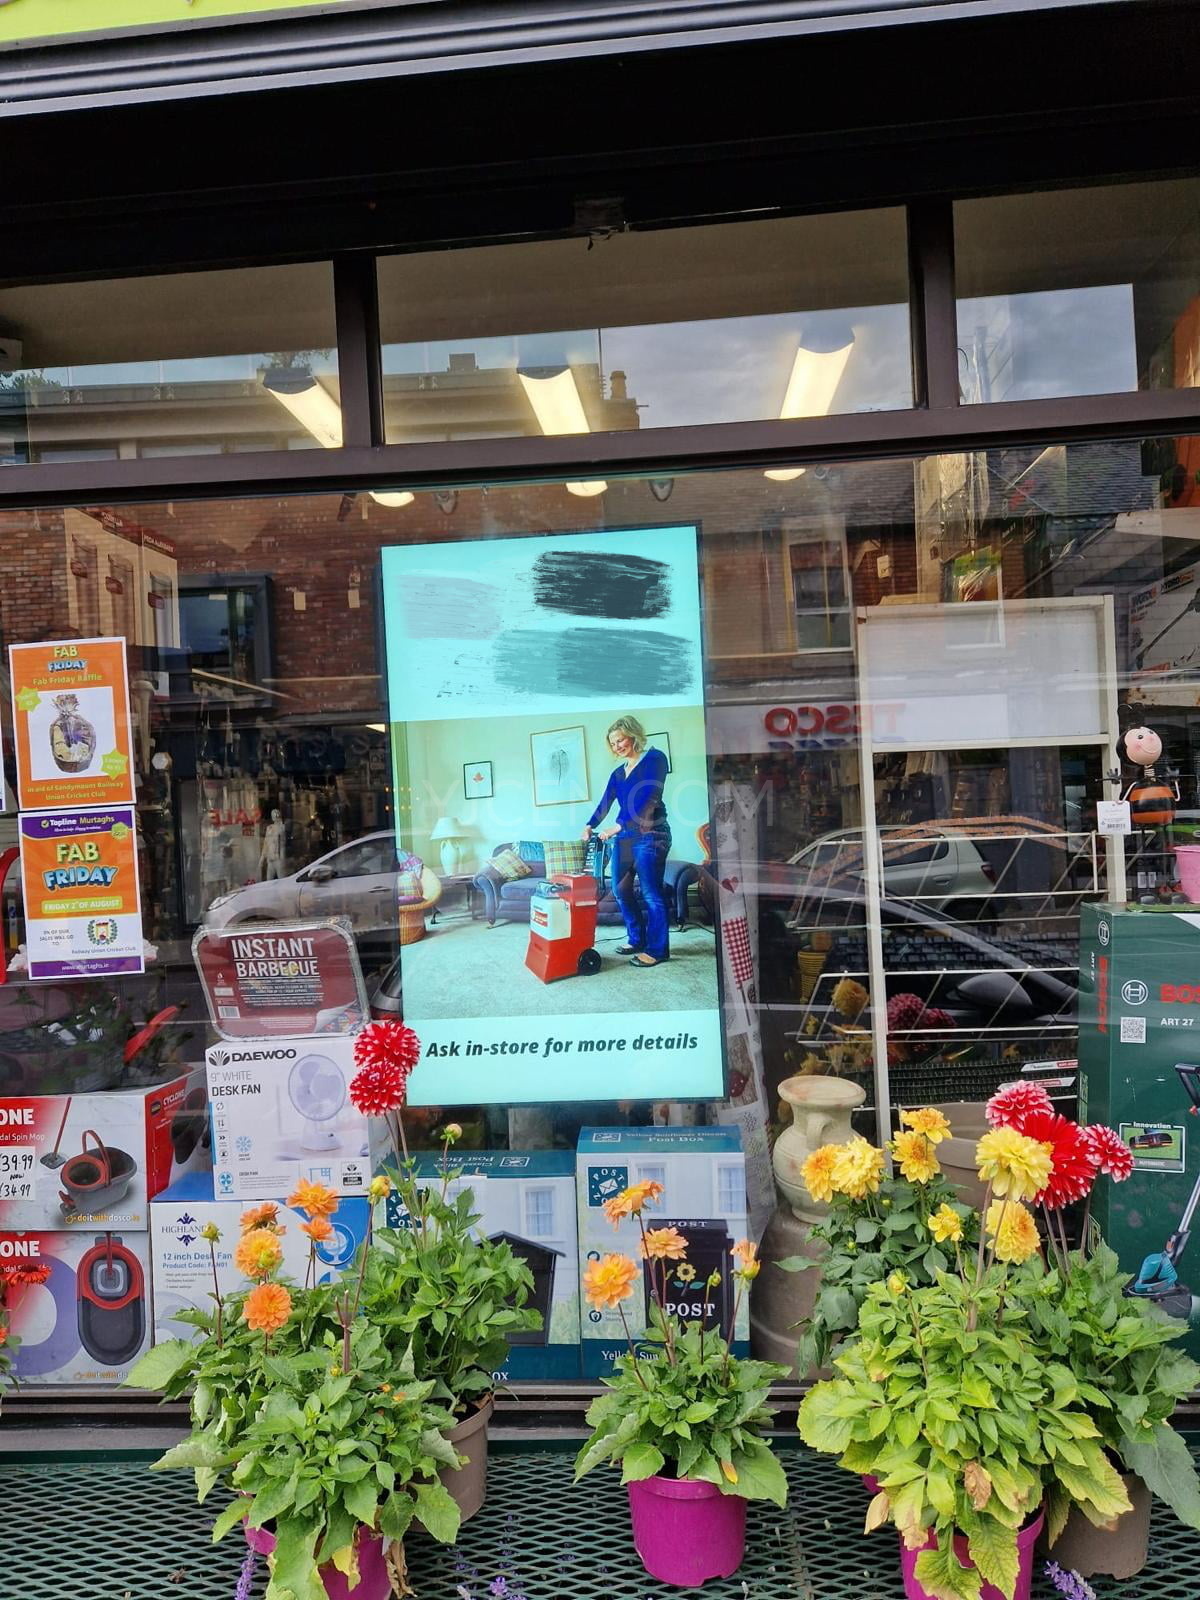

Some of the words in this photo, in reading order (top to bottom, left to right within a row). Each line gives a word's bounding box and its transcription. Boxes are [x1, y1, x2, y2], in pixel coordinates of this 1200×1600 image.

[53, 645, 78, 658] FAB
[47, 660, 88, 673] FRIDAY
[49, 676, 76, 685] Friday
[77, 673, 102, 682] Raffle
[54, 783, 96, 792] Sandymount
[49, 818, 77, 828] Topline
[80, 815, 115, 825] Murtaghs
[56, 842, 100, 863] FAB
[43, 866, 119, 891] FRIDAY
[44, 902, 70, 911] FRIDAY
[90, 899, 120, 908] AUGUST
[231, 937, 315, 959] INSTANT
[236, 960, 320, 978] BARBECUE
[1160, 1017, 1181, 1026] ART
[1182, 1018, 1194, 1027] 27
[425, 1041, 461, 1058] Ask
[465, 1039, 540, 1057] in-store
[541, 1036, 573, 1058] for
[577, 1037, 627, 1053] more
[631, 1032, 699, 1051] details
[231, 1048, 297, 1062] DAEWOO
[222, 1070, 252, 1082] WHITE
[211, 1086, 239, 1097] DESK
[241, 1084, 261, 1095] FAN
[1133, 1121, 1172, 1129] Innovation
[11, 1133, 28, 1142] Spin
[29, 1133, 45, 1141] Mop
[592, 1167, 625, 1182] POST
[667, 1220, 709, 1228] POST
[163, 1252, 172, 1261] 12
[174, 1252, 192, 1260] inch
[217, 1251, 233, 1260] Fan
[666, 1303, 716, 1317] POST
[601, 1350, 636, 1361] Yello
